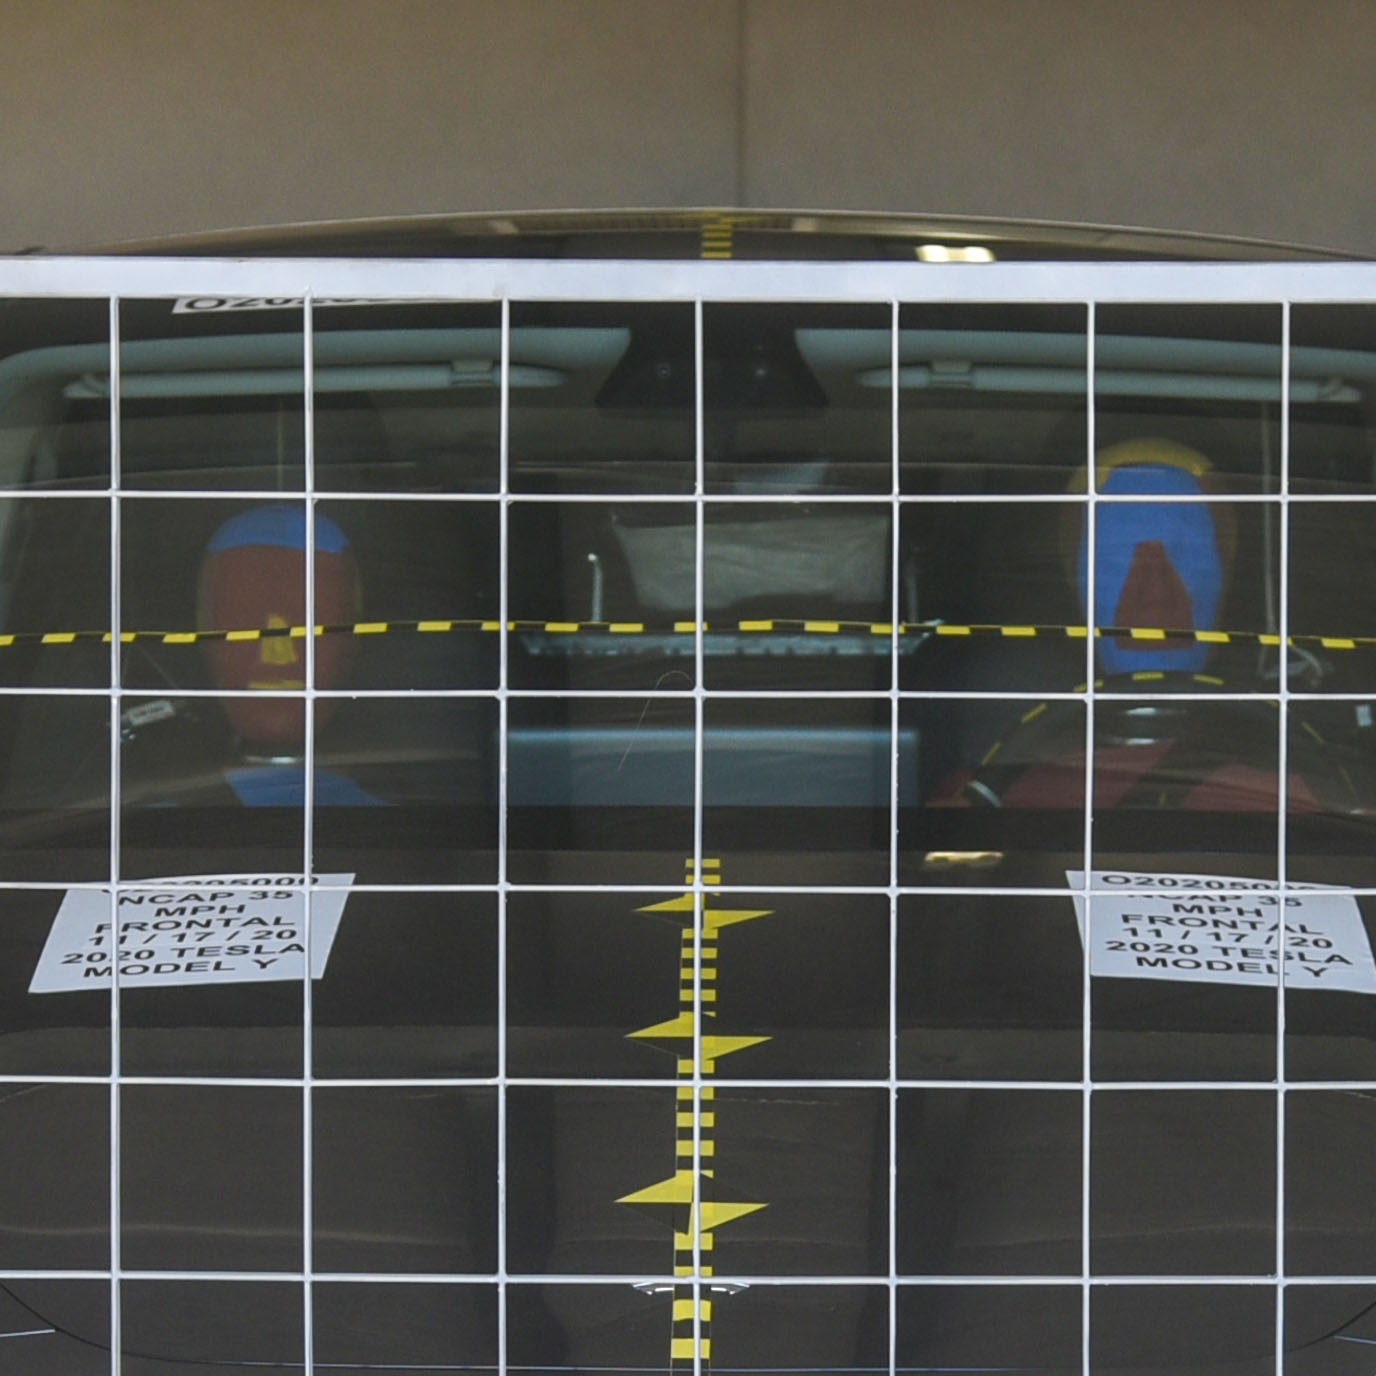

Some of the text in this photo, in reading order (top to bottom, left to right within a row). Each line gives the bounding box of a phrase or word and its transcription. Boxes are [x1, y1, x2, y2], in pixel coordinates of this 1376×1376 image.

[119, 890, 293, 905] NCAP 35
[155, 904, 245, 917] MPH
[1173, 904, 1263, 917] MPH
[95, 916, 295, 934] FRONTAL
[1122, 914, 1323, 934] FRONTAL
[171, 932, 216, 943] 17
[251, 929, 297, 940] 20
[1288, 937, 1333, 949] 20
[61, 943, 305, 965] 2020 TESLA
[1105, 941, 1353, 965] 2020 TESLA
[84, 958, 279, 978] MODEL Y
[1136, 957, 1328, 977] MODEL Y
